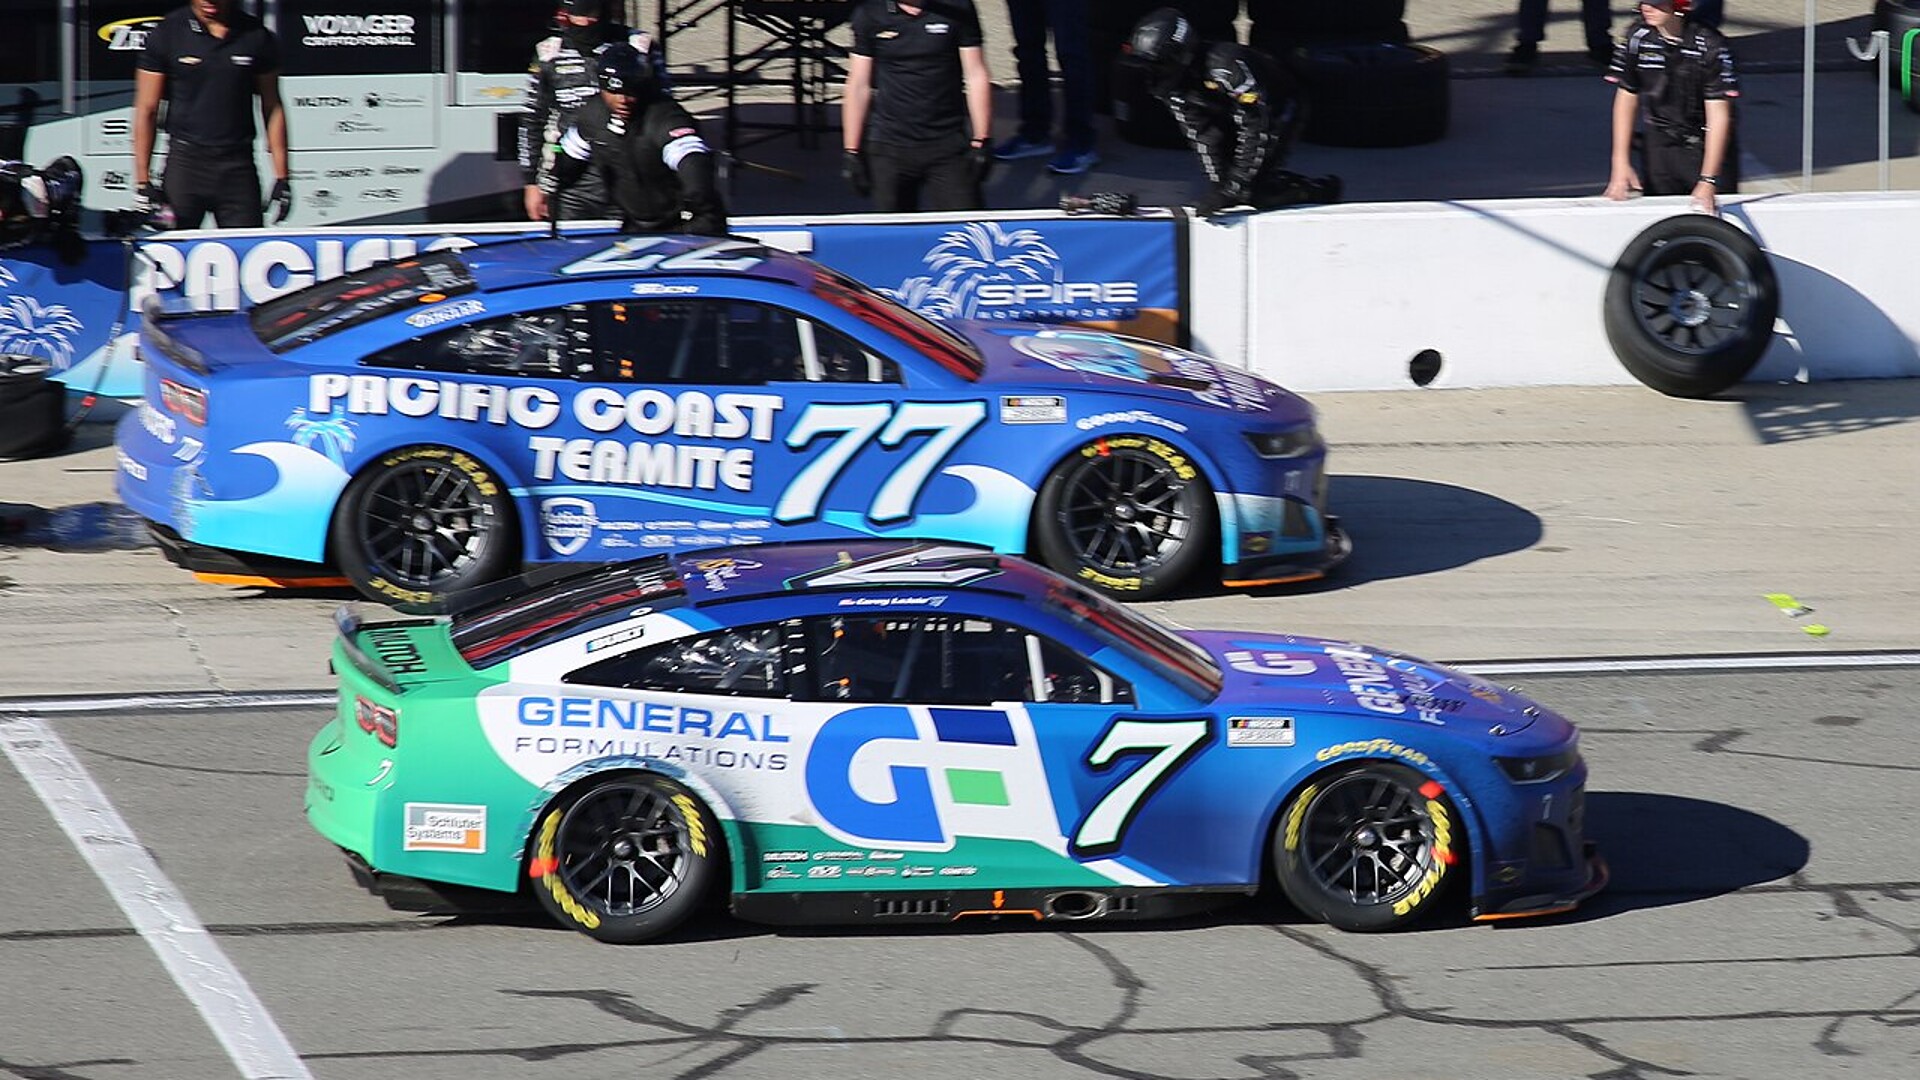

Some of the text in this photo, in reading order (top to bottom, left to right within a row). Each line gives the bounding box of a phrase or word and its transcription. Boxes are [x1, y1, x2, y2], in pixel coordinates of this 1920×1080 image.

[302, 14, 415, 34] VOYAGER
[129, 236, 478, 313] PACIF
[976, 282, 1139, 306] SPIRE
[976, 307, 1138, 320] MOTORSPORTS
[309, 373, 783, 442] PACIFIC COAST
[529, 436, 755, 492] TERMITE
[773, 400, 987, 525] 77
[518, 696, 791, 744] GENERAL
[366, 758, 393, 787] 7
[515, 736, 788, 771] FORMULATIONS
[1073, 716, 1212, 860] 7
